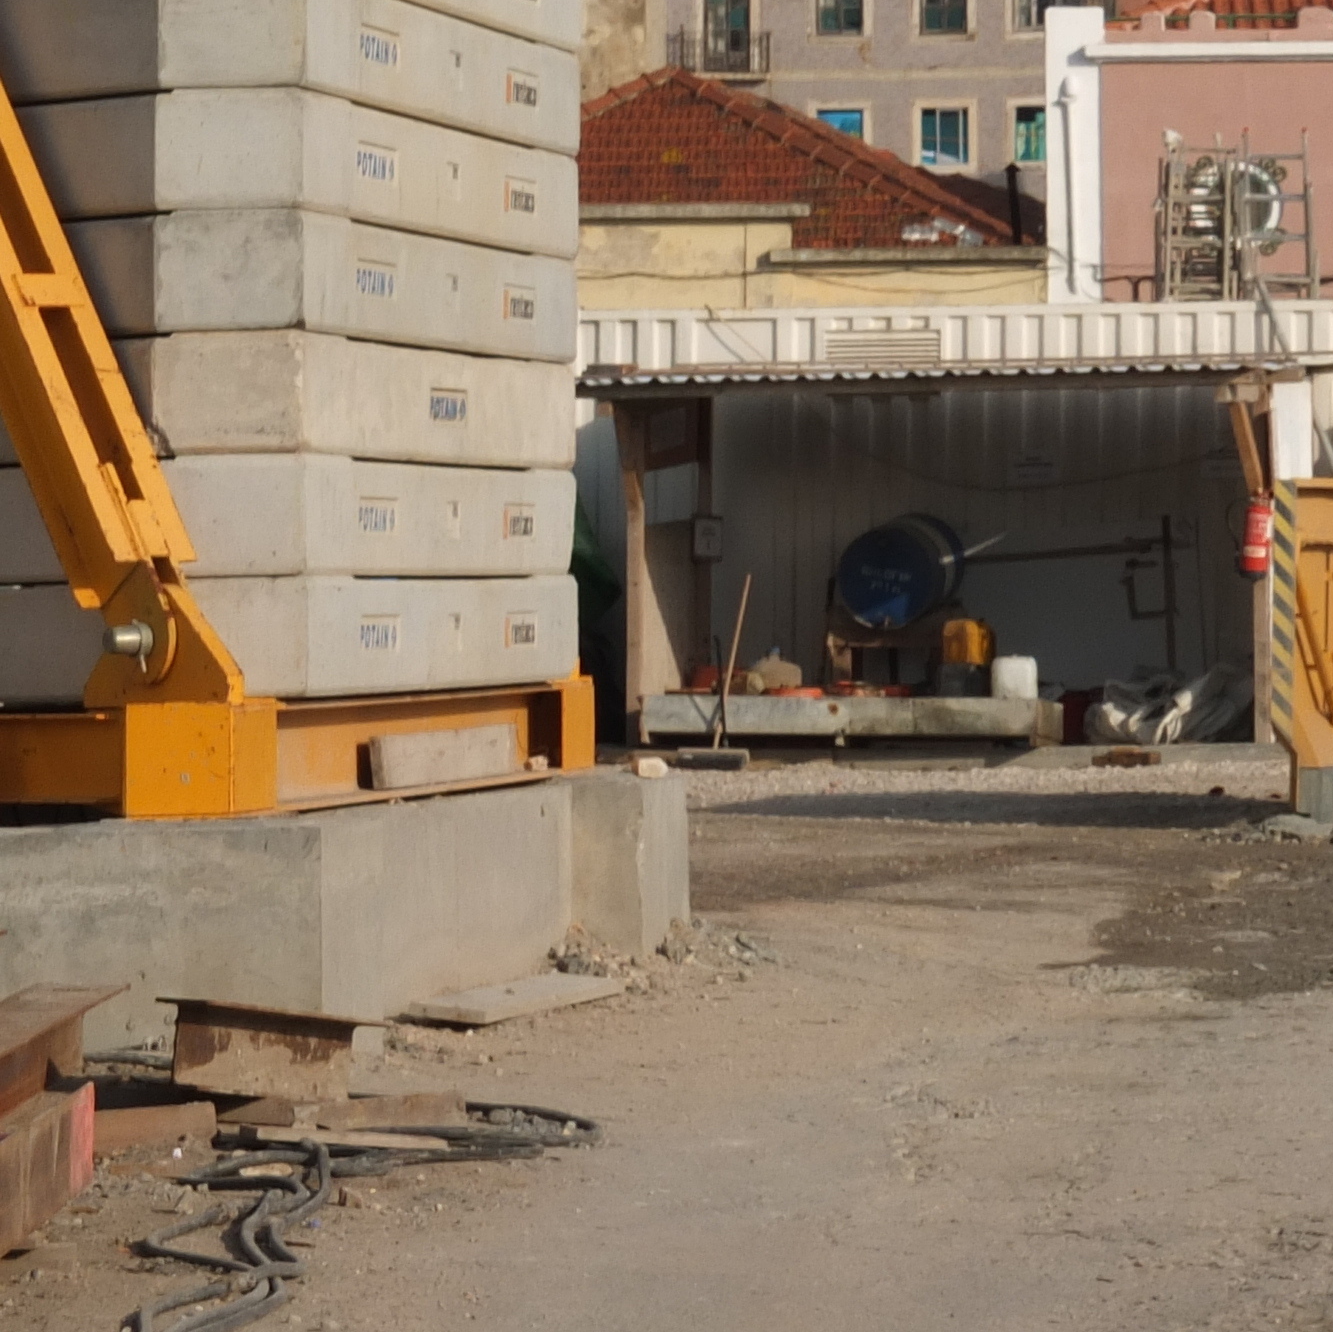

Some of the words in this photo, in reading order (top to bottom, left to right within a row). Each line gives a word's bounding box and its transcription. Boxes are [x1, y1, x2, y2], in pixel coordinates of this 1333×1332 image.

[360, 34, 389, 65] POTAIN
[357, 151, 387, 180] POTAIN
[357, 268, 386, 297] POTAIN
[359, 506, 388, 532] POTAIN
[360, 624, 390, 649] POTAIN
